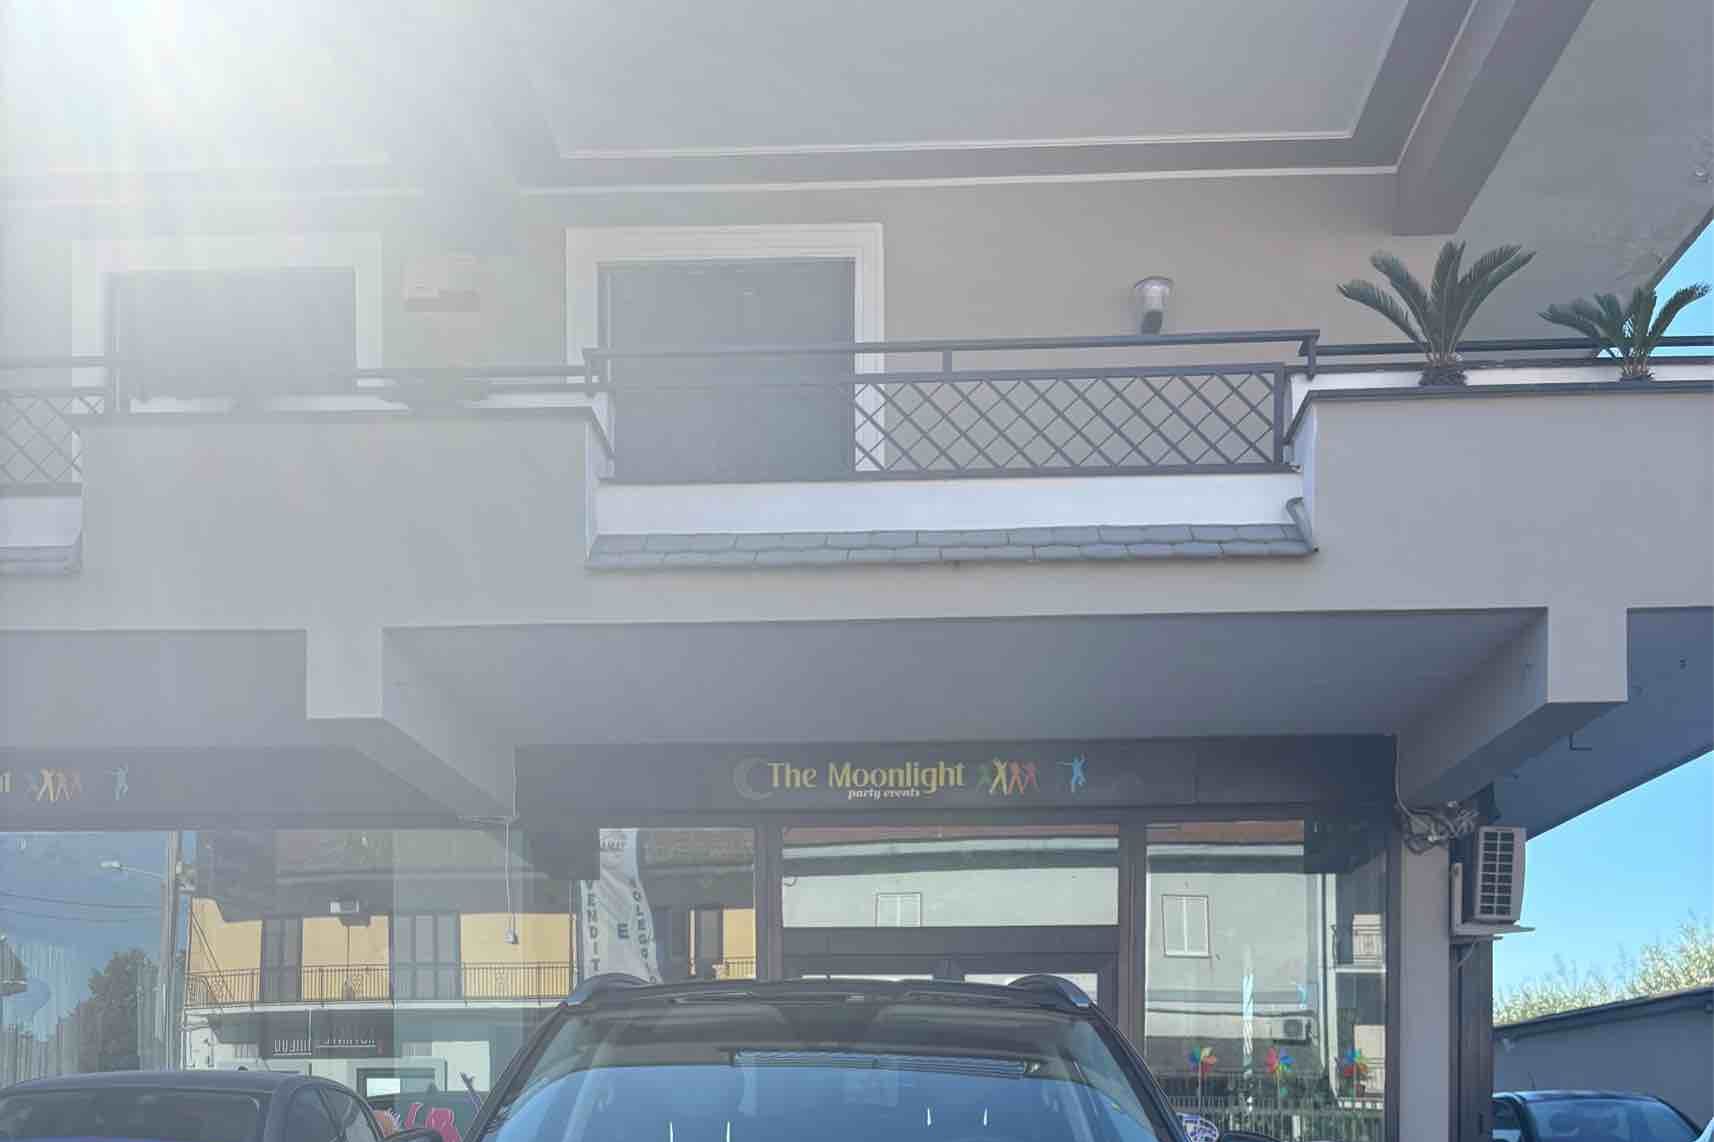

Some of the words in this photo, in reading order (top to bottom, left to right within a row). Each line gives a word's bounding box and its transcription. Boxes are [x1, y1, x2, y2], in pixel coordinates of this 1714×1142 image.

[768, 762, 816, 788] The
[828, 760, 966, 793] Moonlight
[848, 786, 881, 800] party
